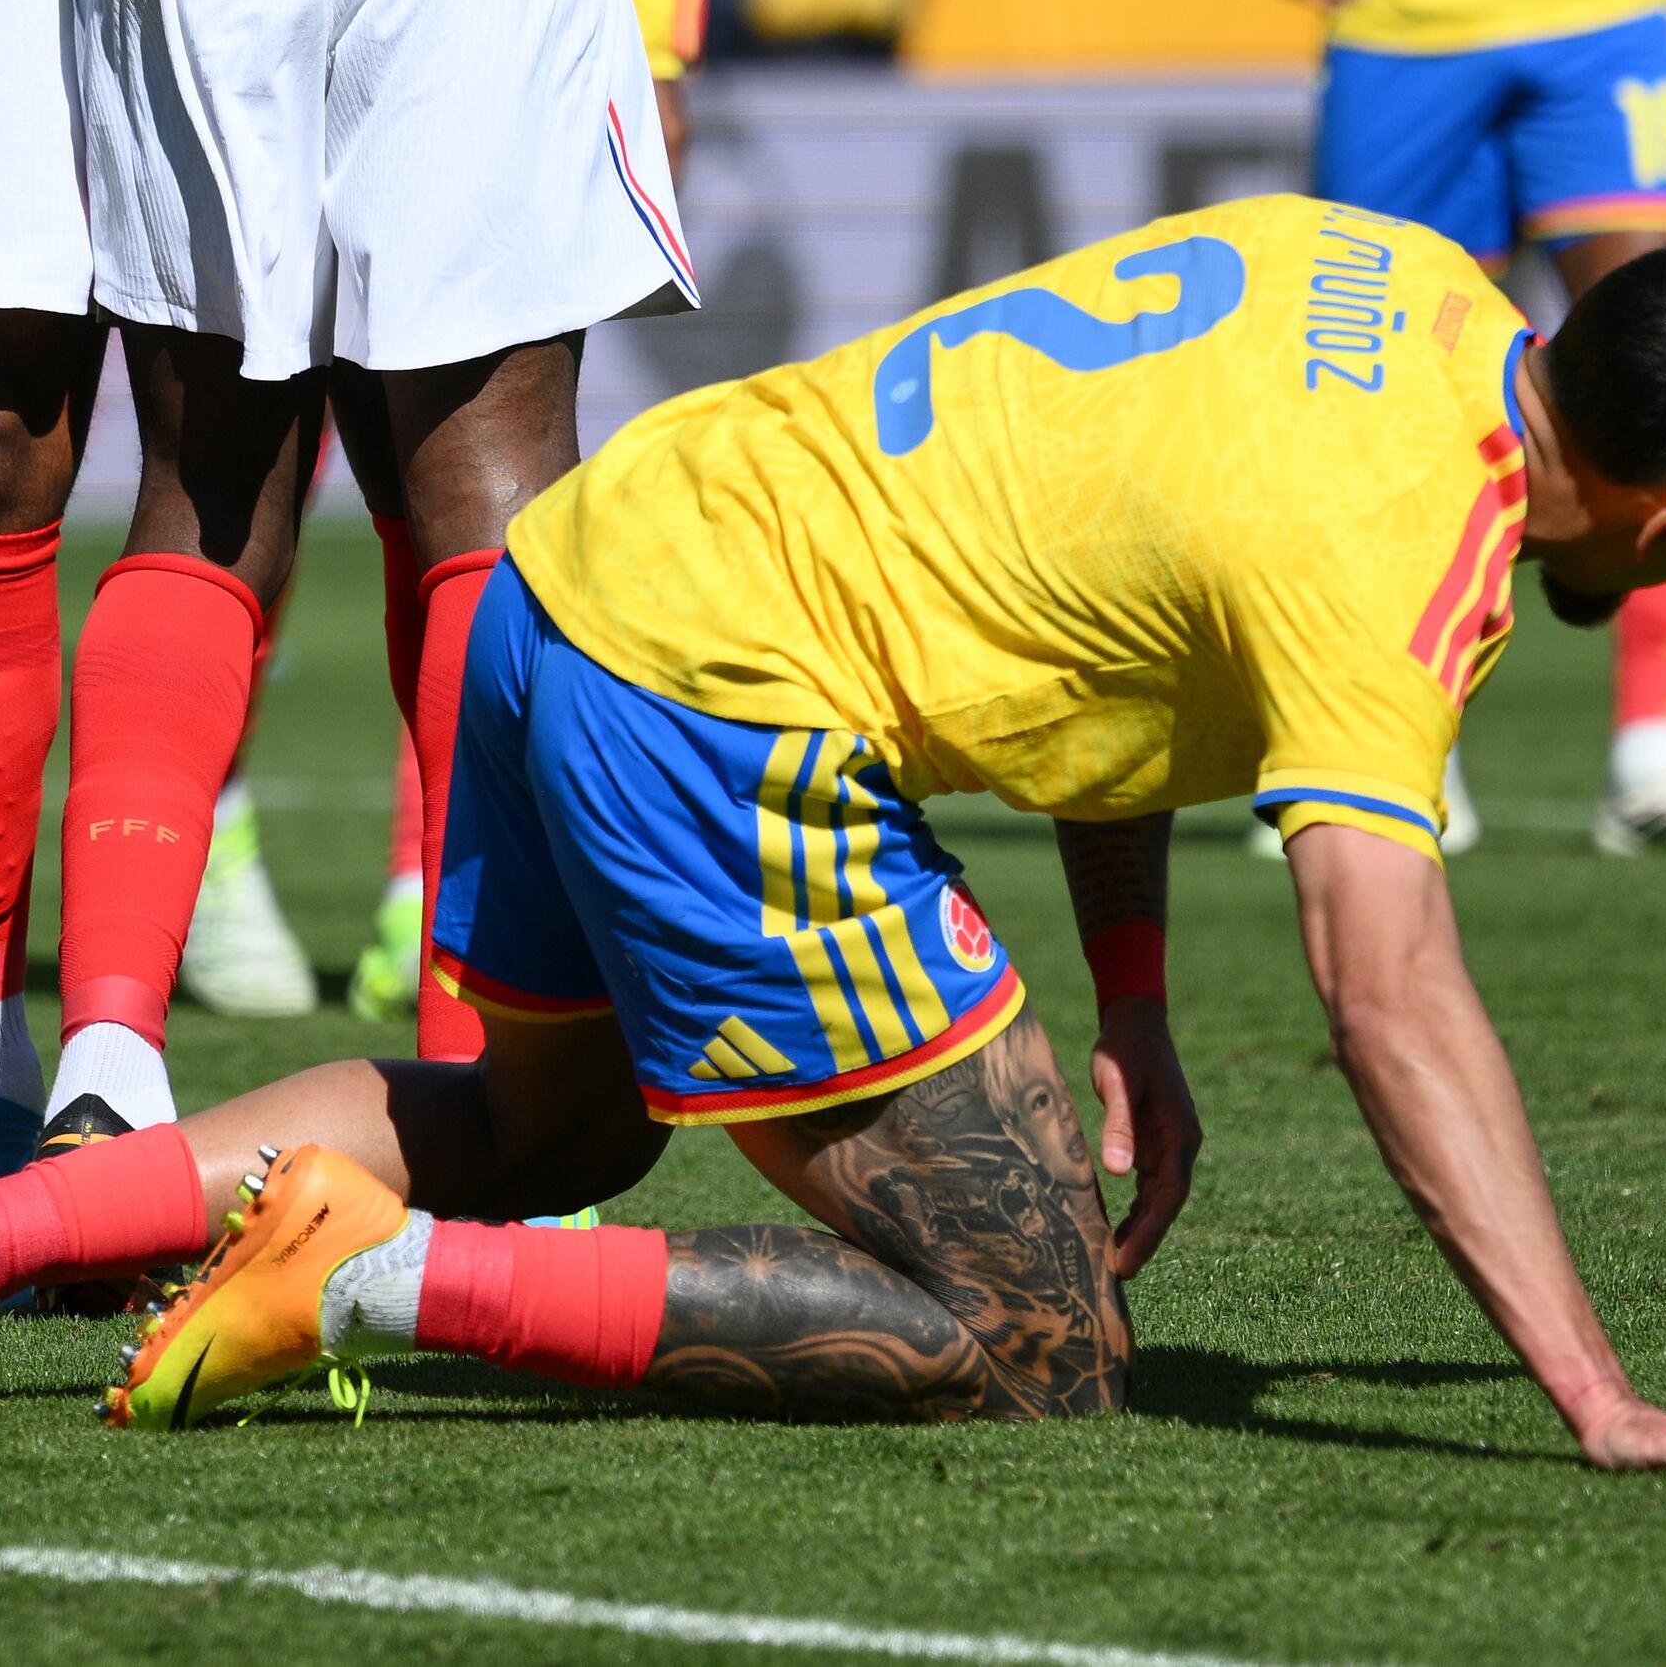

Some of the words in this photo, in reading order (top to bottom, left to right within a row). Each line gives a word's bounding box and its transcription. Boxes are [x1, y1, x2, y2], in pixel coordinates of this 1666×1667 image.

[874, 236, 1246, 457] 2
[89, 818, 182, 844] FFF
[271, 1202, 330, 1268] MERCURIAL
